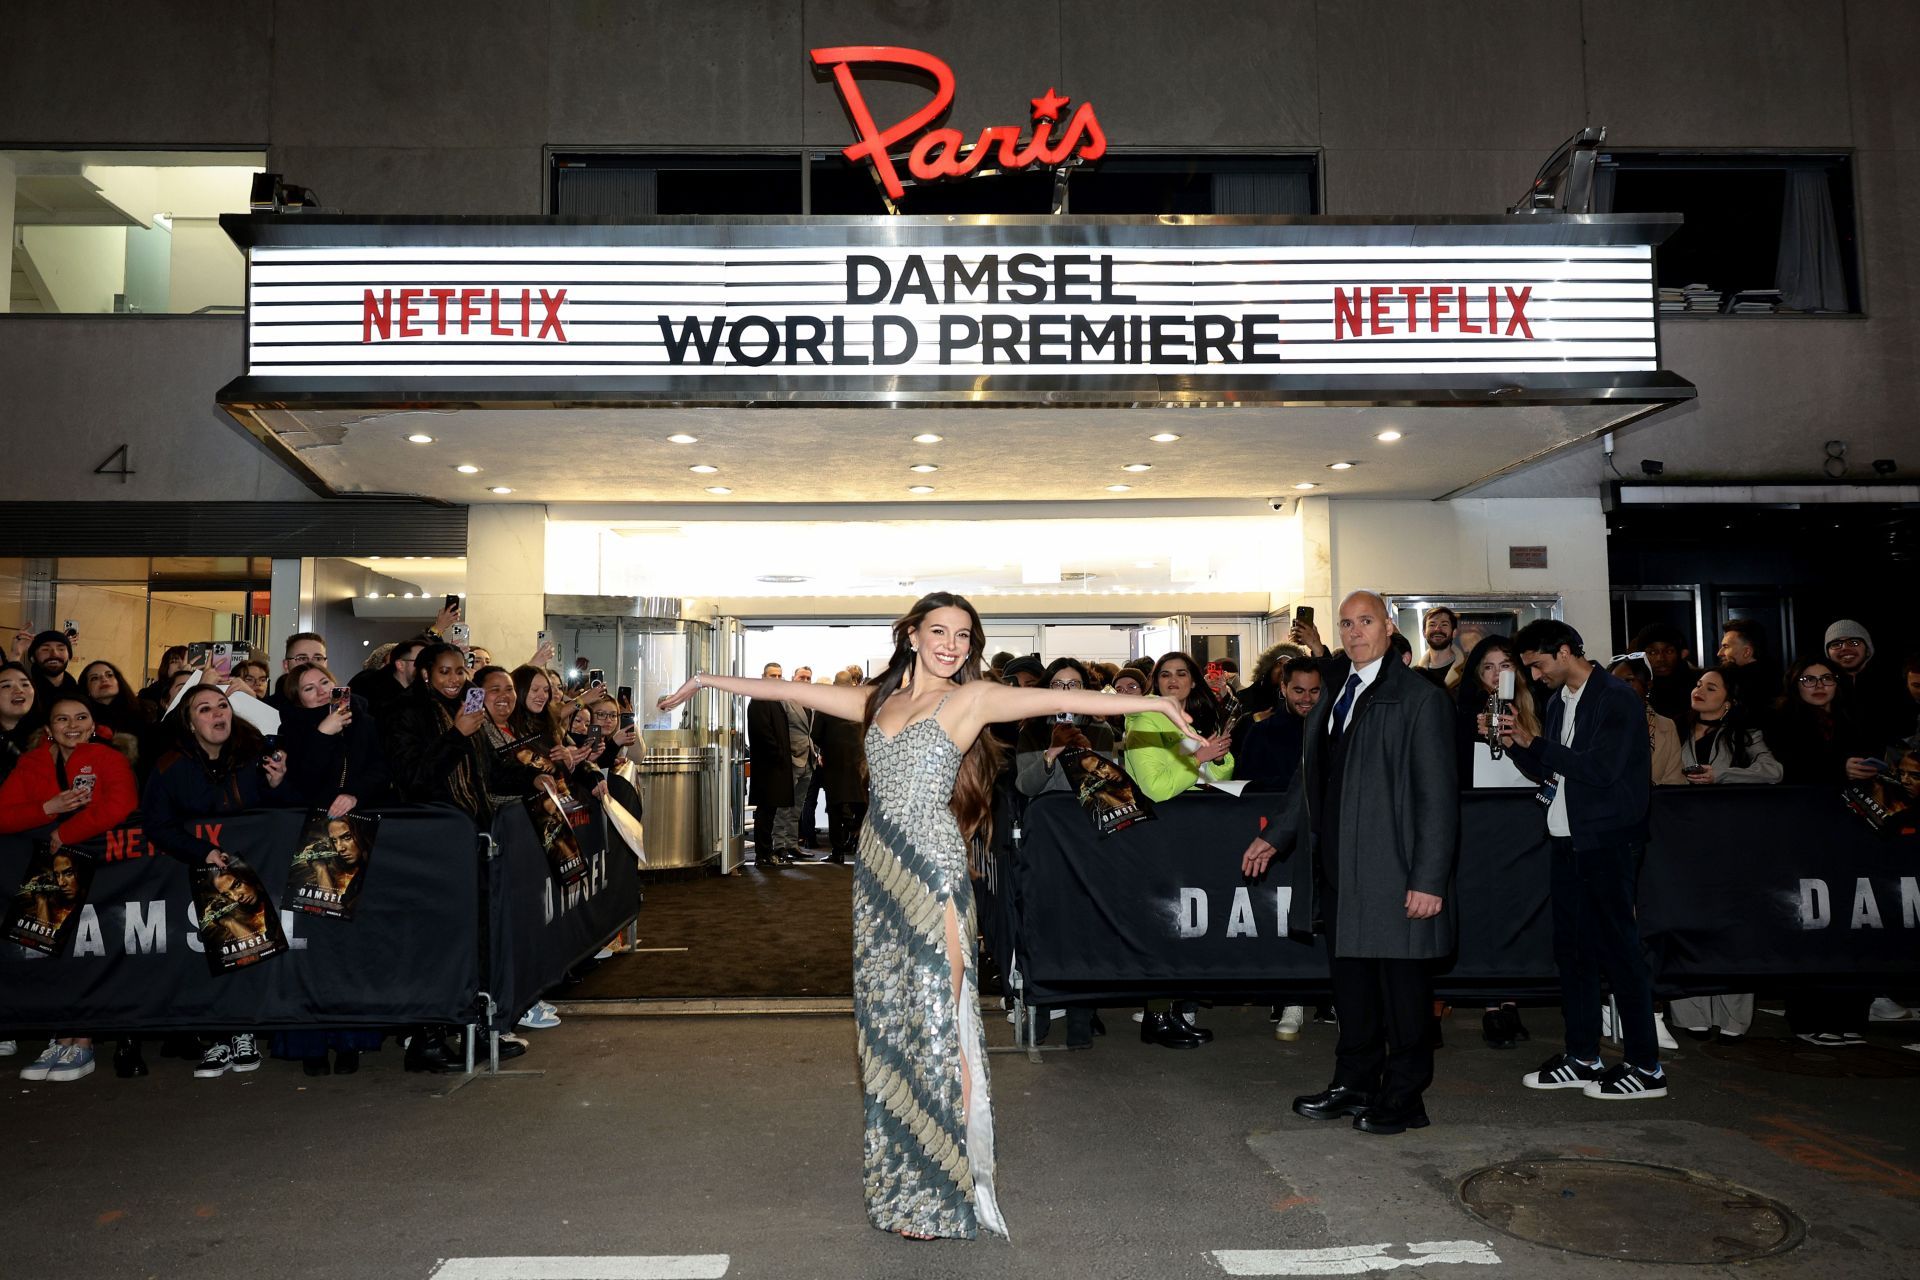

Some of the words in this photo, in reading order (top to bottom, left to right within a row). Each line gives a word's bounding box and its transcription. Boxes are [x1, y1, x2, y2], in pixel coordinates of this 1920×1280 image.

[810, 46, 1107, 199] Paris
[845, 253, 1136, 305] DAMSEL
[364, 288, 567, 343] NETFLIX
[1334, 286, 1534, 340] NETFLIX
[657, 315, 918, 367] WORLD
[939, 314, 1281, 365] PREMIERE
[94, 444, 136, 483] 4
[1102, 804, 1139, 823] DAMSEL
[1535, 792, 1551, 806] STAFF
[1852, 787, 1888, 820] DAMSEL
[299, 887, 343, 904] DAMSEL
[16, 918, 56, 939] DAMSEL
[221, 933, 269, 955] DAMSEL
